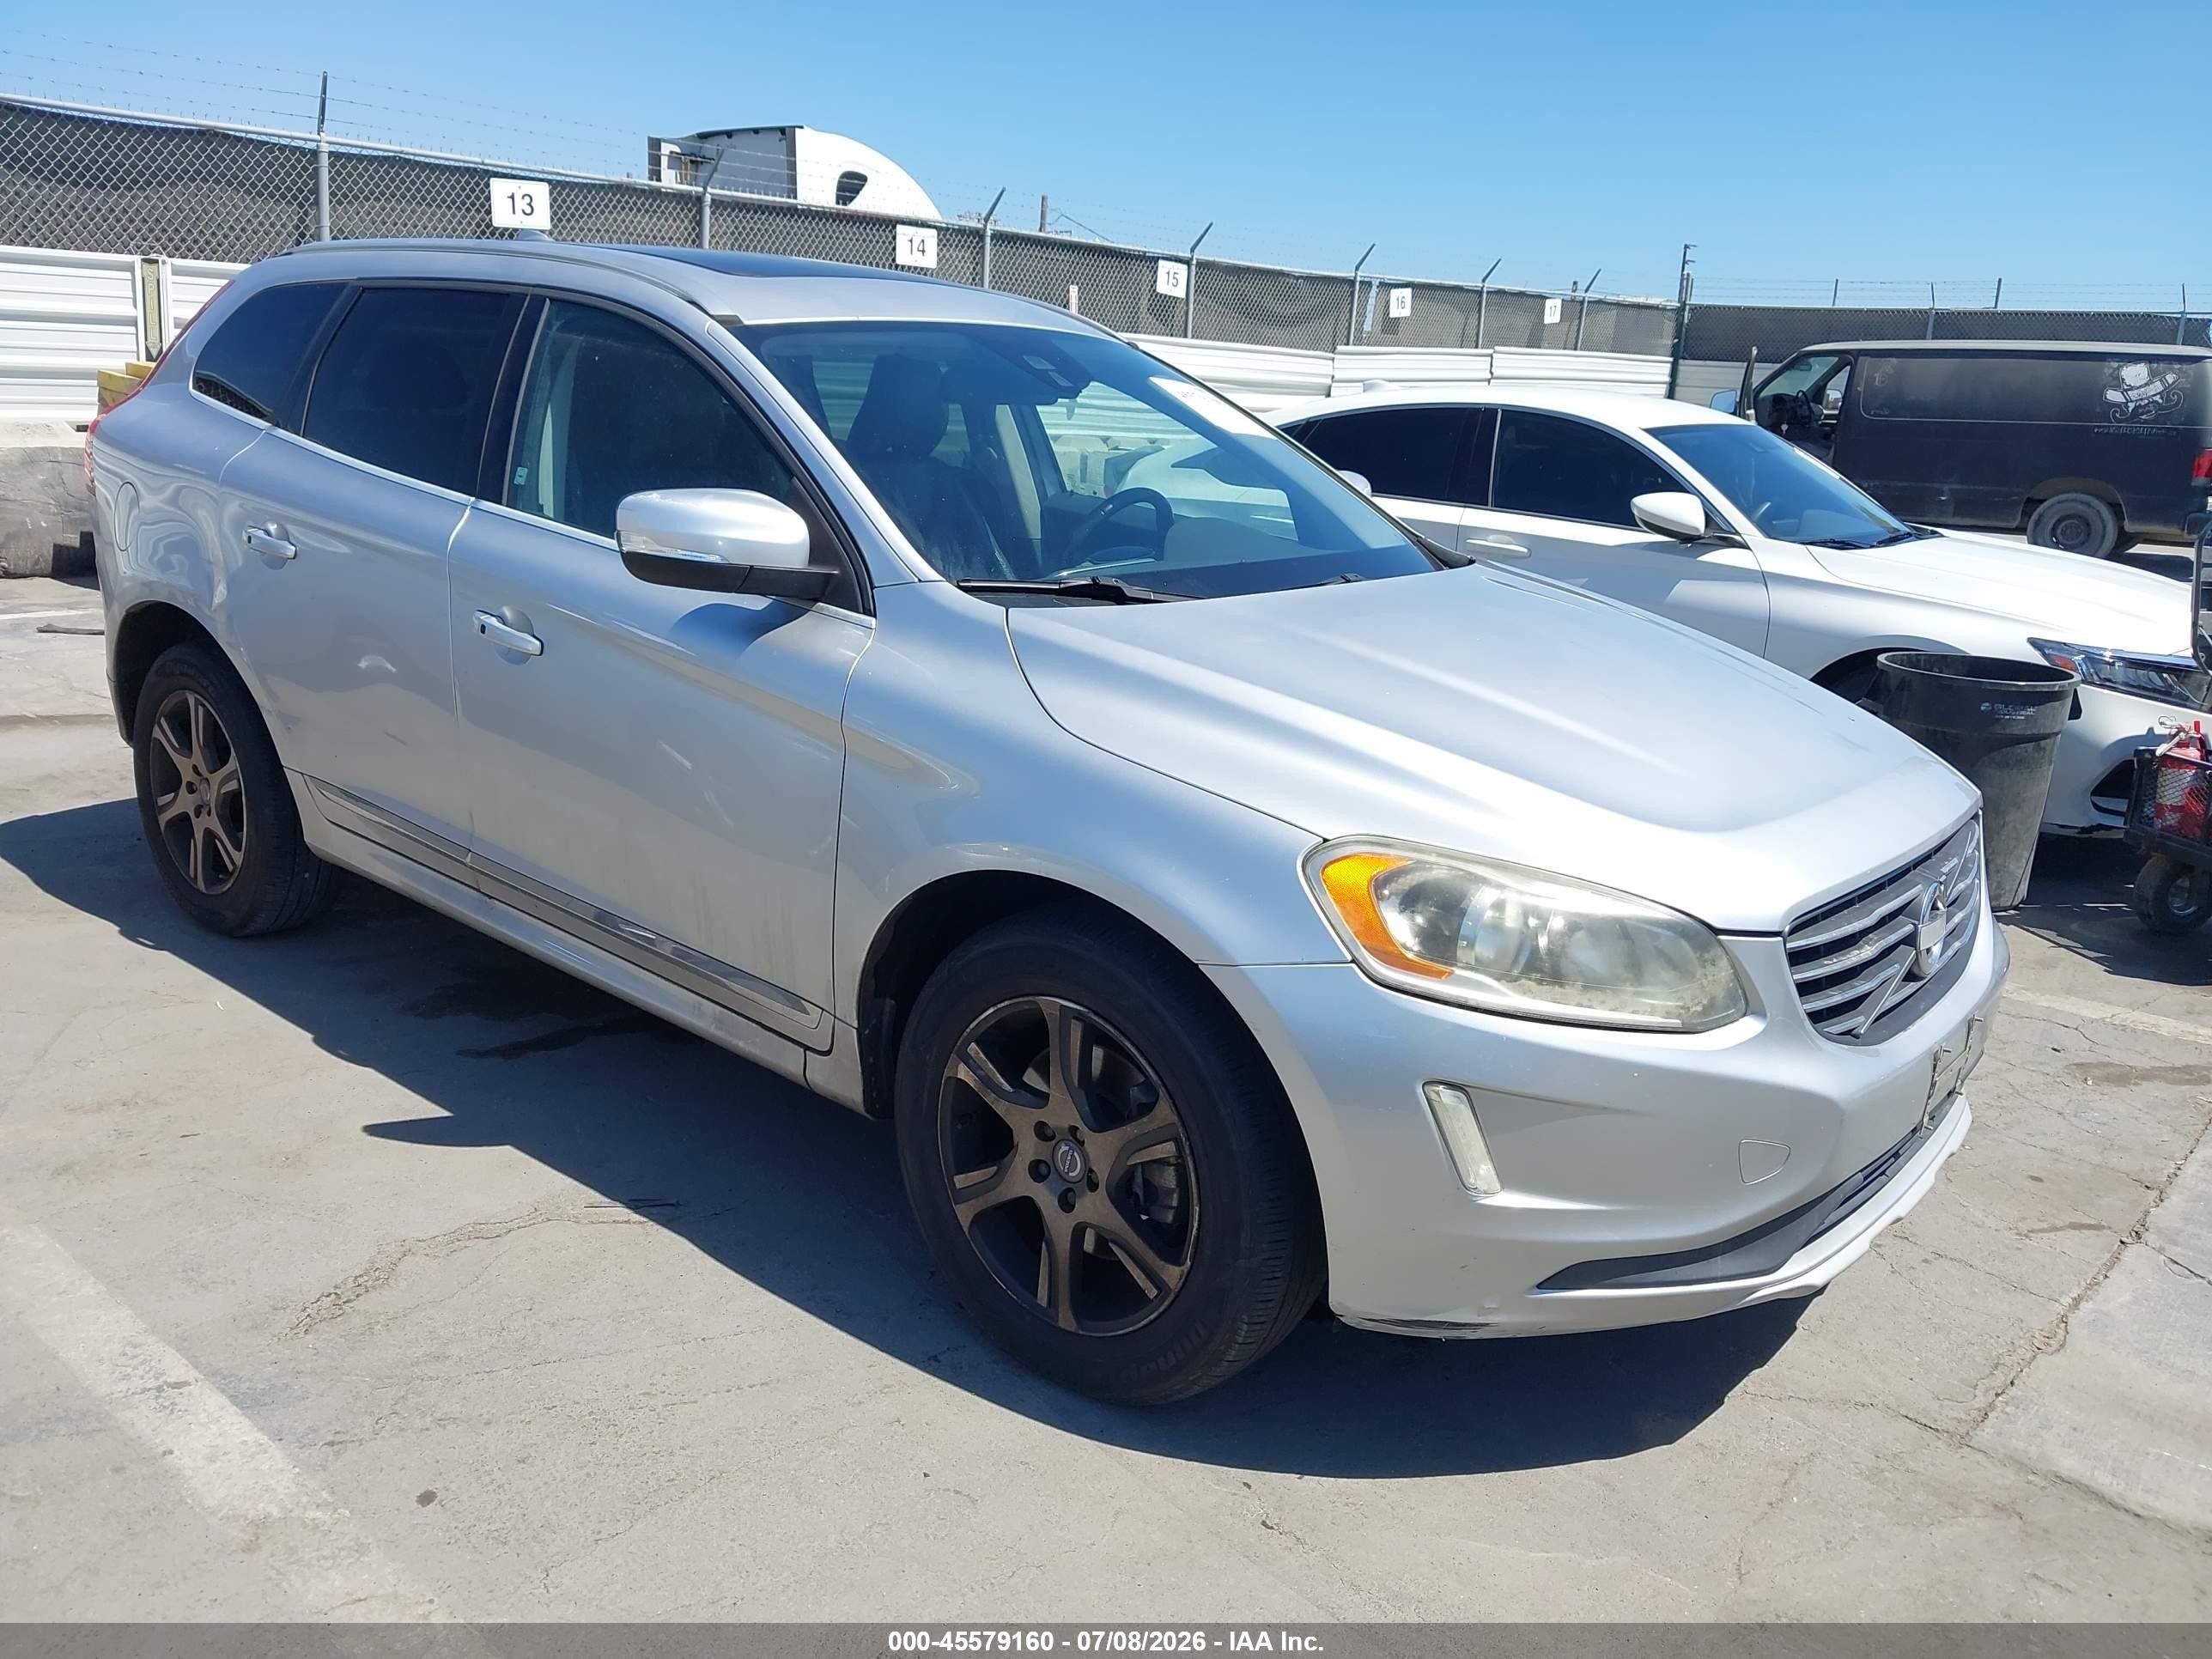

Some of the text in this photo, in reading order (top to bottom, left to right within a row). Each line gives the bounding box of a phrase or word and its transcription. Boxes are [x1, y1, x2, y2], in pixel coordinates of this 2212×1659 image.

[507, 191, 534, 216] 13
[908, 236, 926, 257] 14
[1165, 270, 1179, 288] 15
[147, 268, 157, 340] SPILL
[1396, 295, 1406, 309] 16
[1549, 305, 1557, 317] 17
